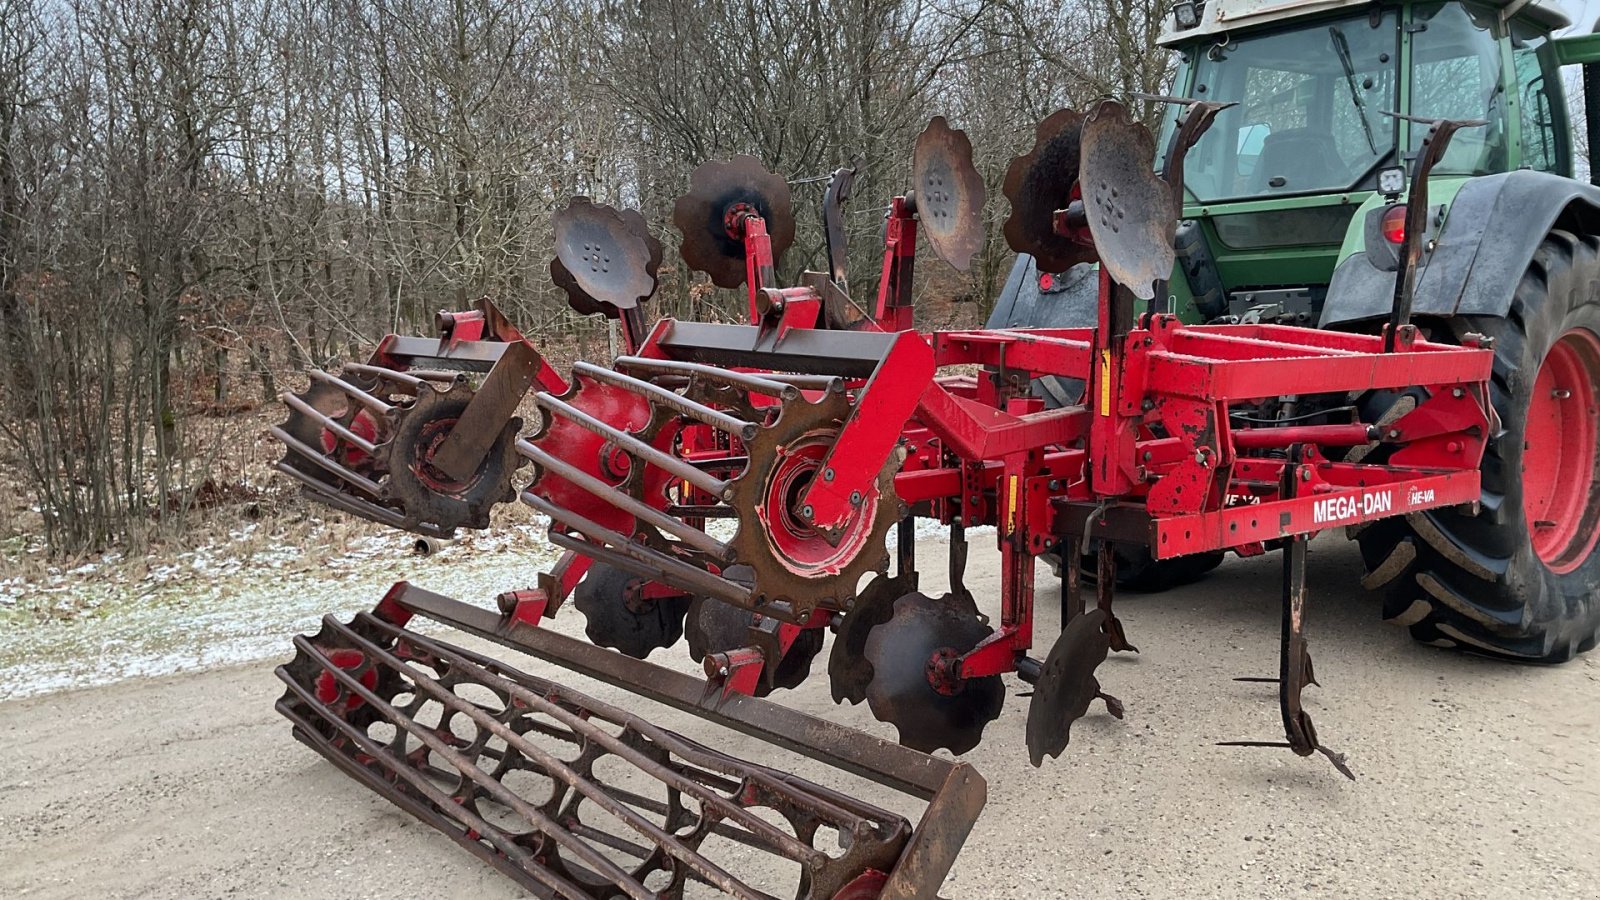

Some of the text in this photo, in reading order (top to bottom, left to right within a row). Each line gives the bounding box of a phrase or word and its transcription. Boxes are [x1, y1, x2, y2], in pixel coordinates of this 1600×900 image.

[1224, 493, 1260, 506] EVA
[1411, 489, 1435, 505] HE-VA
[1314, 490, 1391, 523] MEGA-DAN
